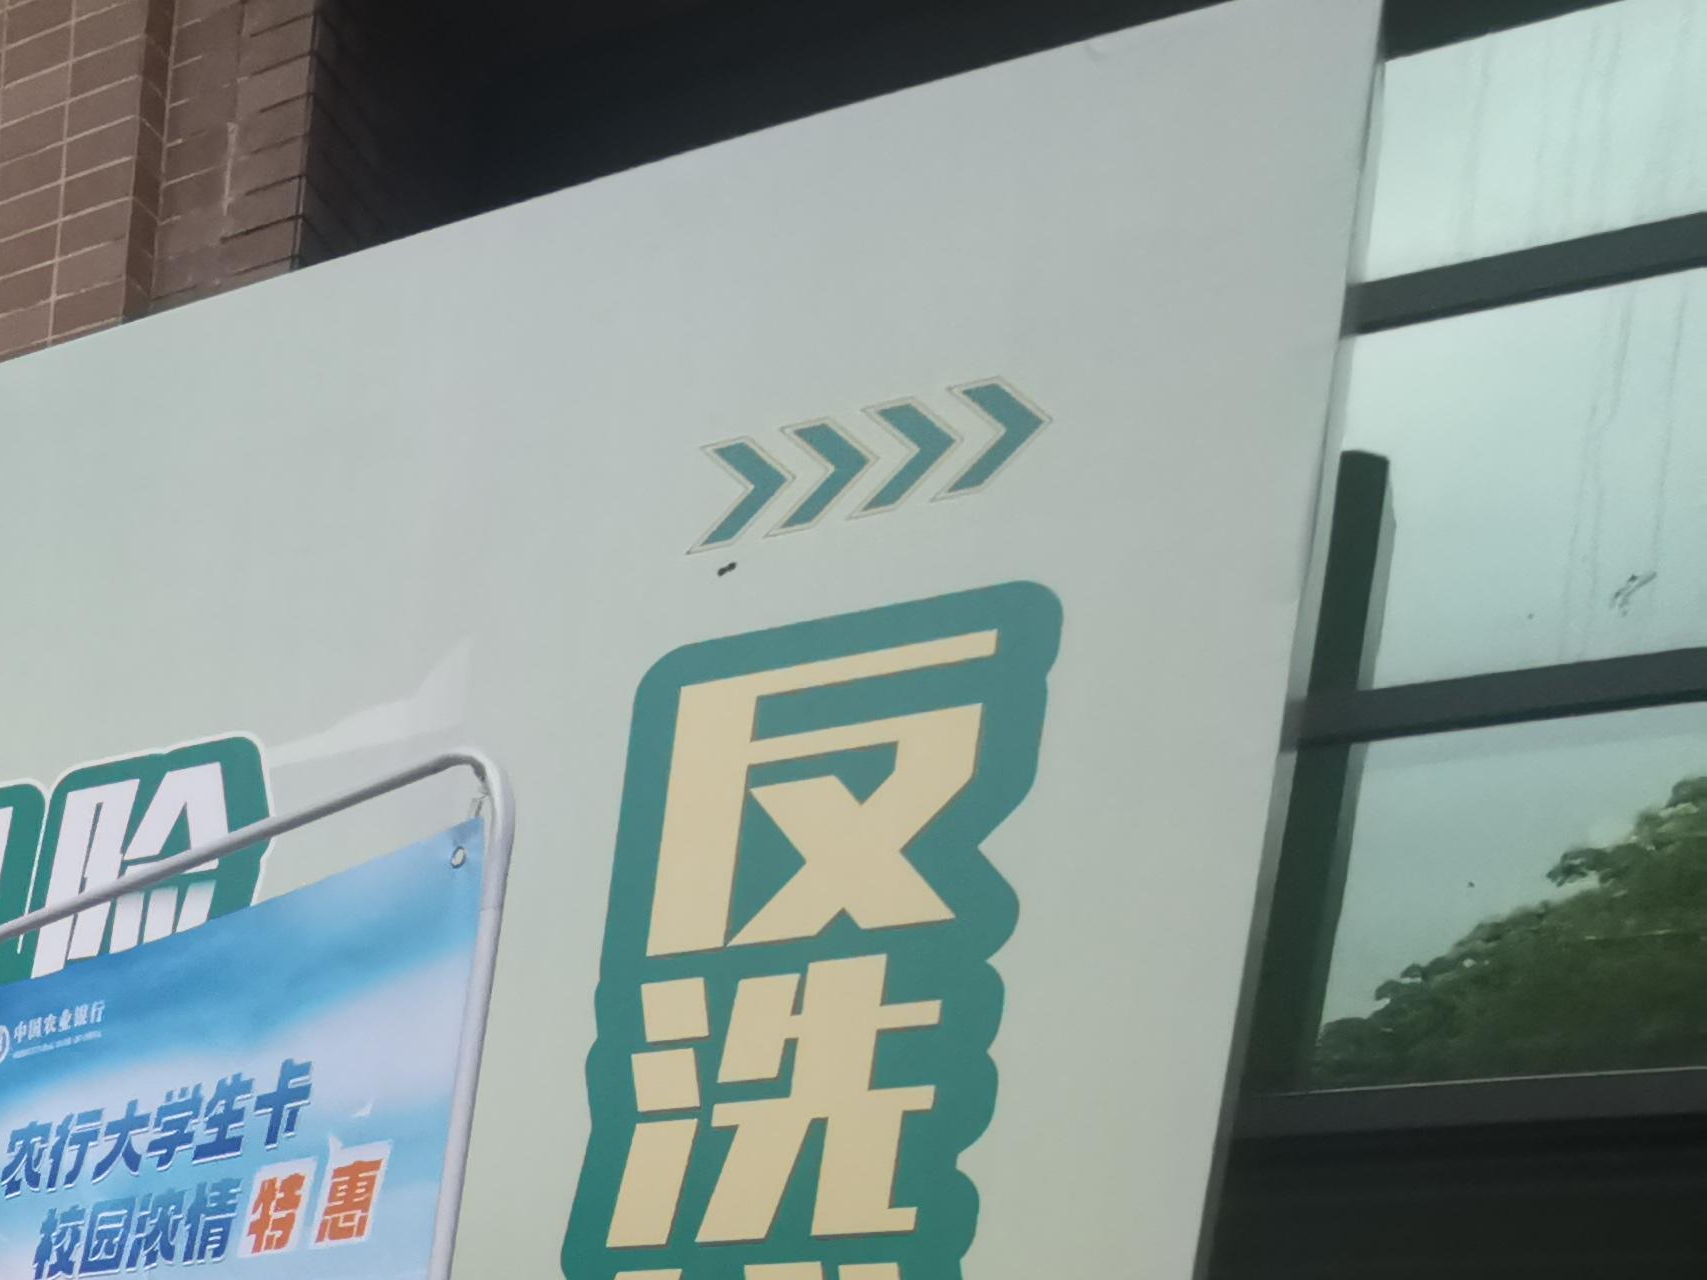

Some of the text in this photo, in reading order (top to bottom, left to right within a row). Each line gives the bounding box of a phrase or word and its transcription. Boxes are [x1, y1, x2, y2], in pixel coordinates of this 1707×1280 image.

[13, 1000, 106, 1044] 中国农业银行
[0, 1058, 313, 1200] 农行大学生卡
